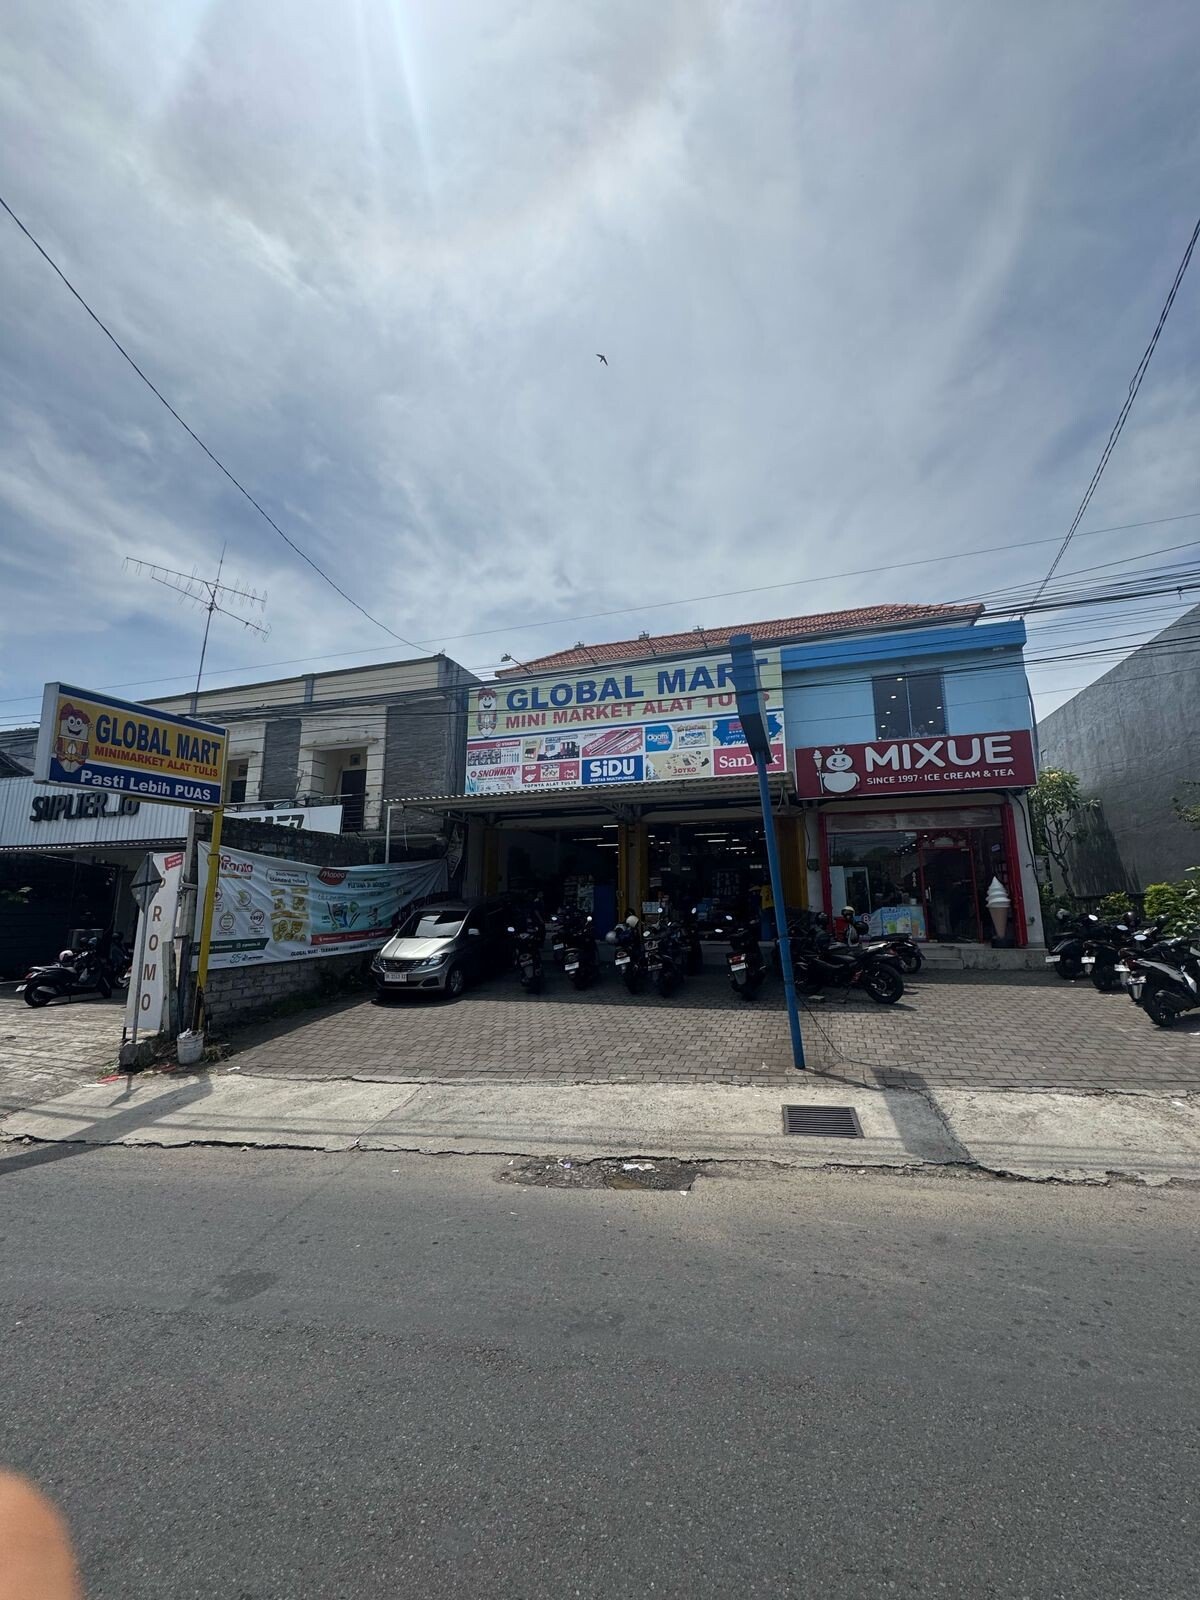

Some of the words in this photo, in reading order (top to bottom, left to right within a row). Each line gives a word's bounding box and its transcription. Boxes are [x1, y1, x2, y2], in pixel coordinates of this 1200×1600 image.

[506, 675, 644, 711] GLOBAL
[505, 711, 546, 729] MINI
[553, 702, 636, 725] MARKET
[642, 695, 695, 715] ALAT
[95, 714, 171, 757] GLOBAL
[176, 733, 221, 767] MART
[864, 735, 1014, 773] MIXUE
[94, 745, 165, 767] MINIMARKET
[167, 759, 191, 773] ALAT
[193, 764, 218, 777] TULIS
[478, 767, 517, 778] SNOWMAN
[590, 758, 635, 777] SiDU
[672, 766, 697, 774] JOYKO
[866, 776, 896, 785] SINCE
[897, 774, 918, 783] 1997
[924, 773, 941, 782] ICE
[943, 771, 981, 781] CREAM
[983, 769, 991, 778] &
[993, 768, 1015, 777] TEA
[80, 769, 124, 788] Pasti
[129, 777, 170, 795] Lebih
[174, 784, 211, 801] PUAS
